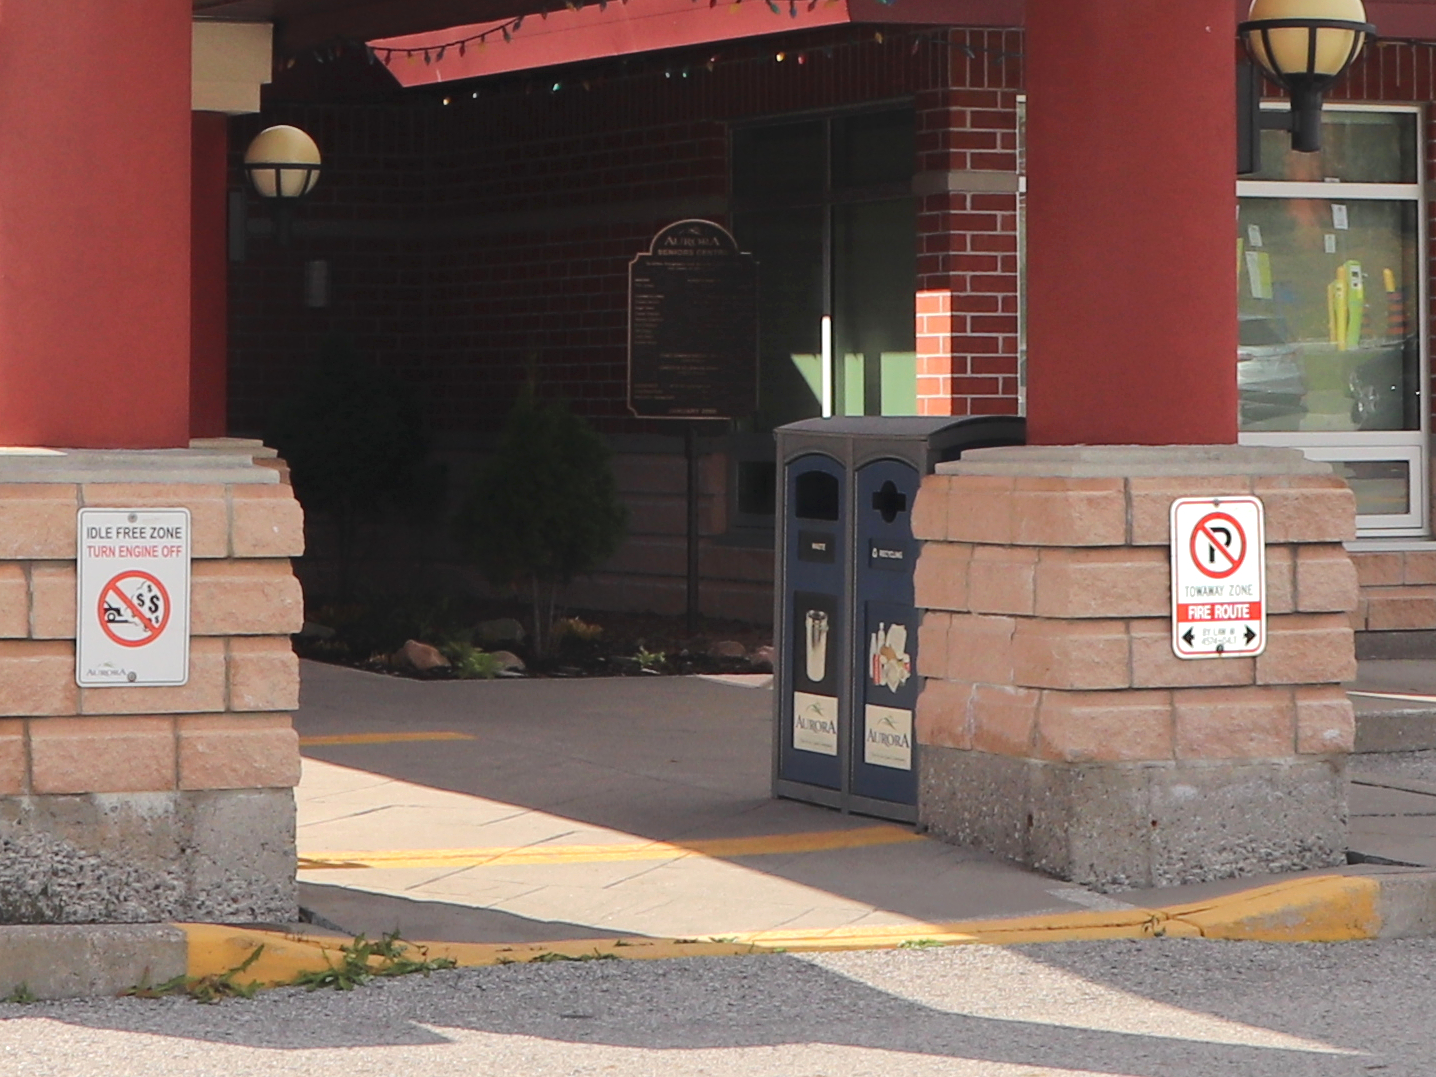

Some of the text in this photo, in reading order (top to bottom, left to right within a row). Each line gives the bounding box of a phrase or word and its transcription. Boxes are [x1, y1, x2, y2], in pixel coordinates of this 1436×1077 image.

[664, 236, 720, 246] AURORA
[658, 248, 694, 256] SENIORS
[86, 527, 182, 539] IDLE FREE ZONE
[87, 545, 182, 558] TURN ENGINE OFF
[1185, 584, 1254, 597] TOWAWAY ZONE
[1188, 604, 1250, 619] FIRE ROUTE
[86, 668, 127, 677] AURORA
[795, 714, 837, 735] AURORA
[867, 728, 910, 749] AURORA
